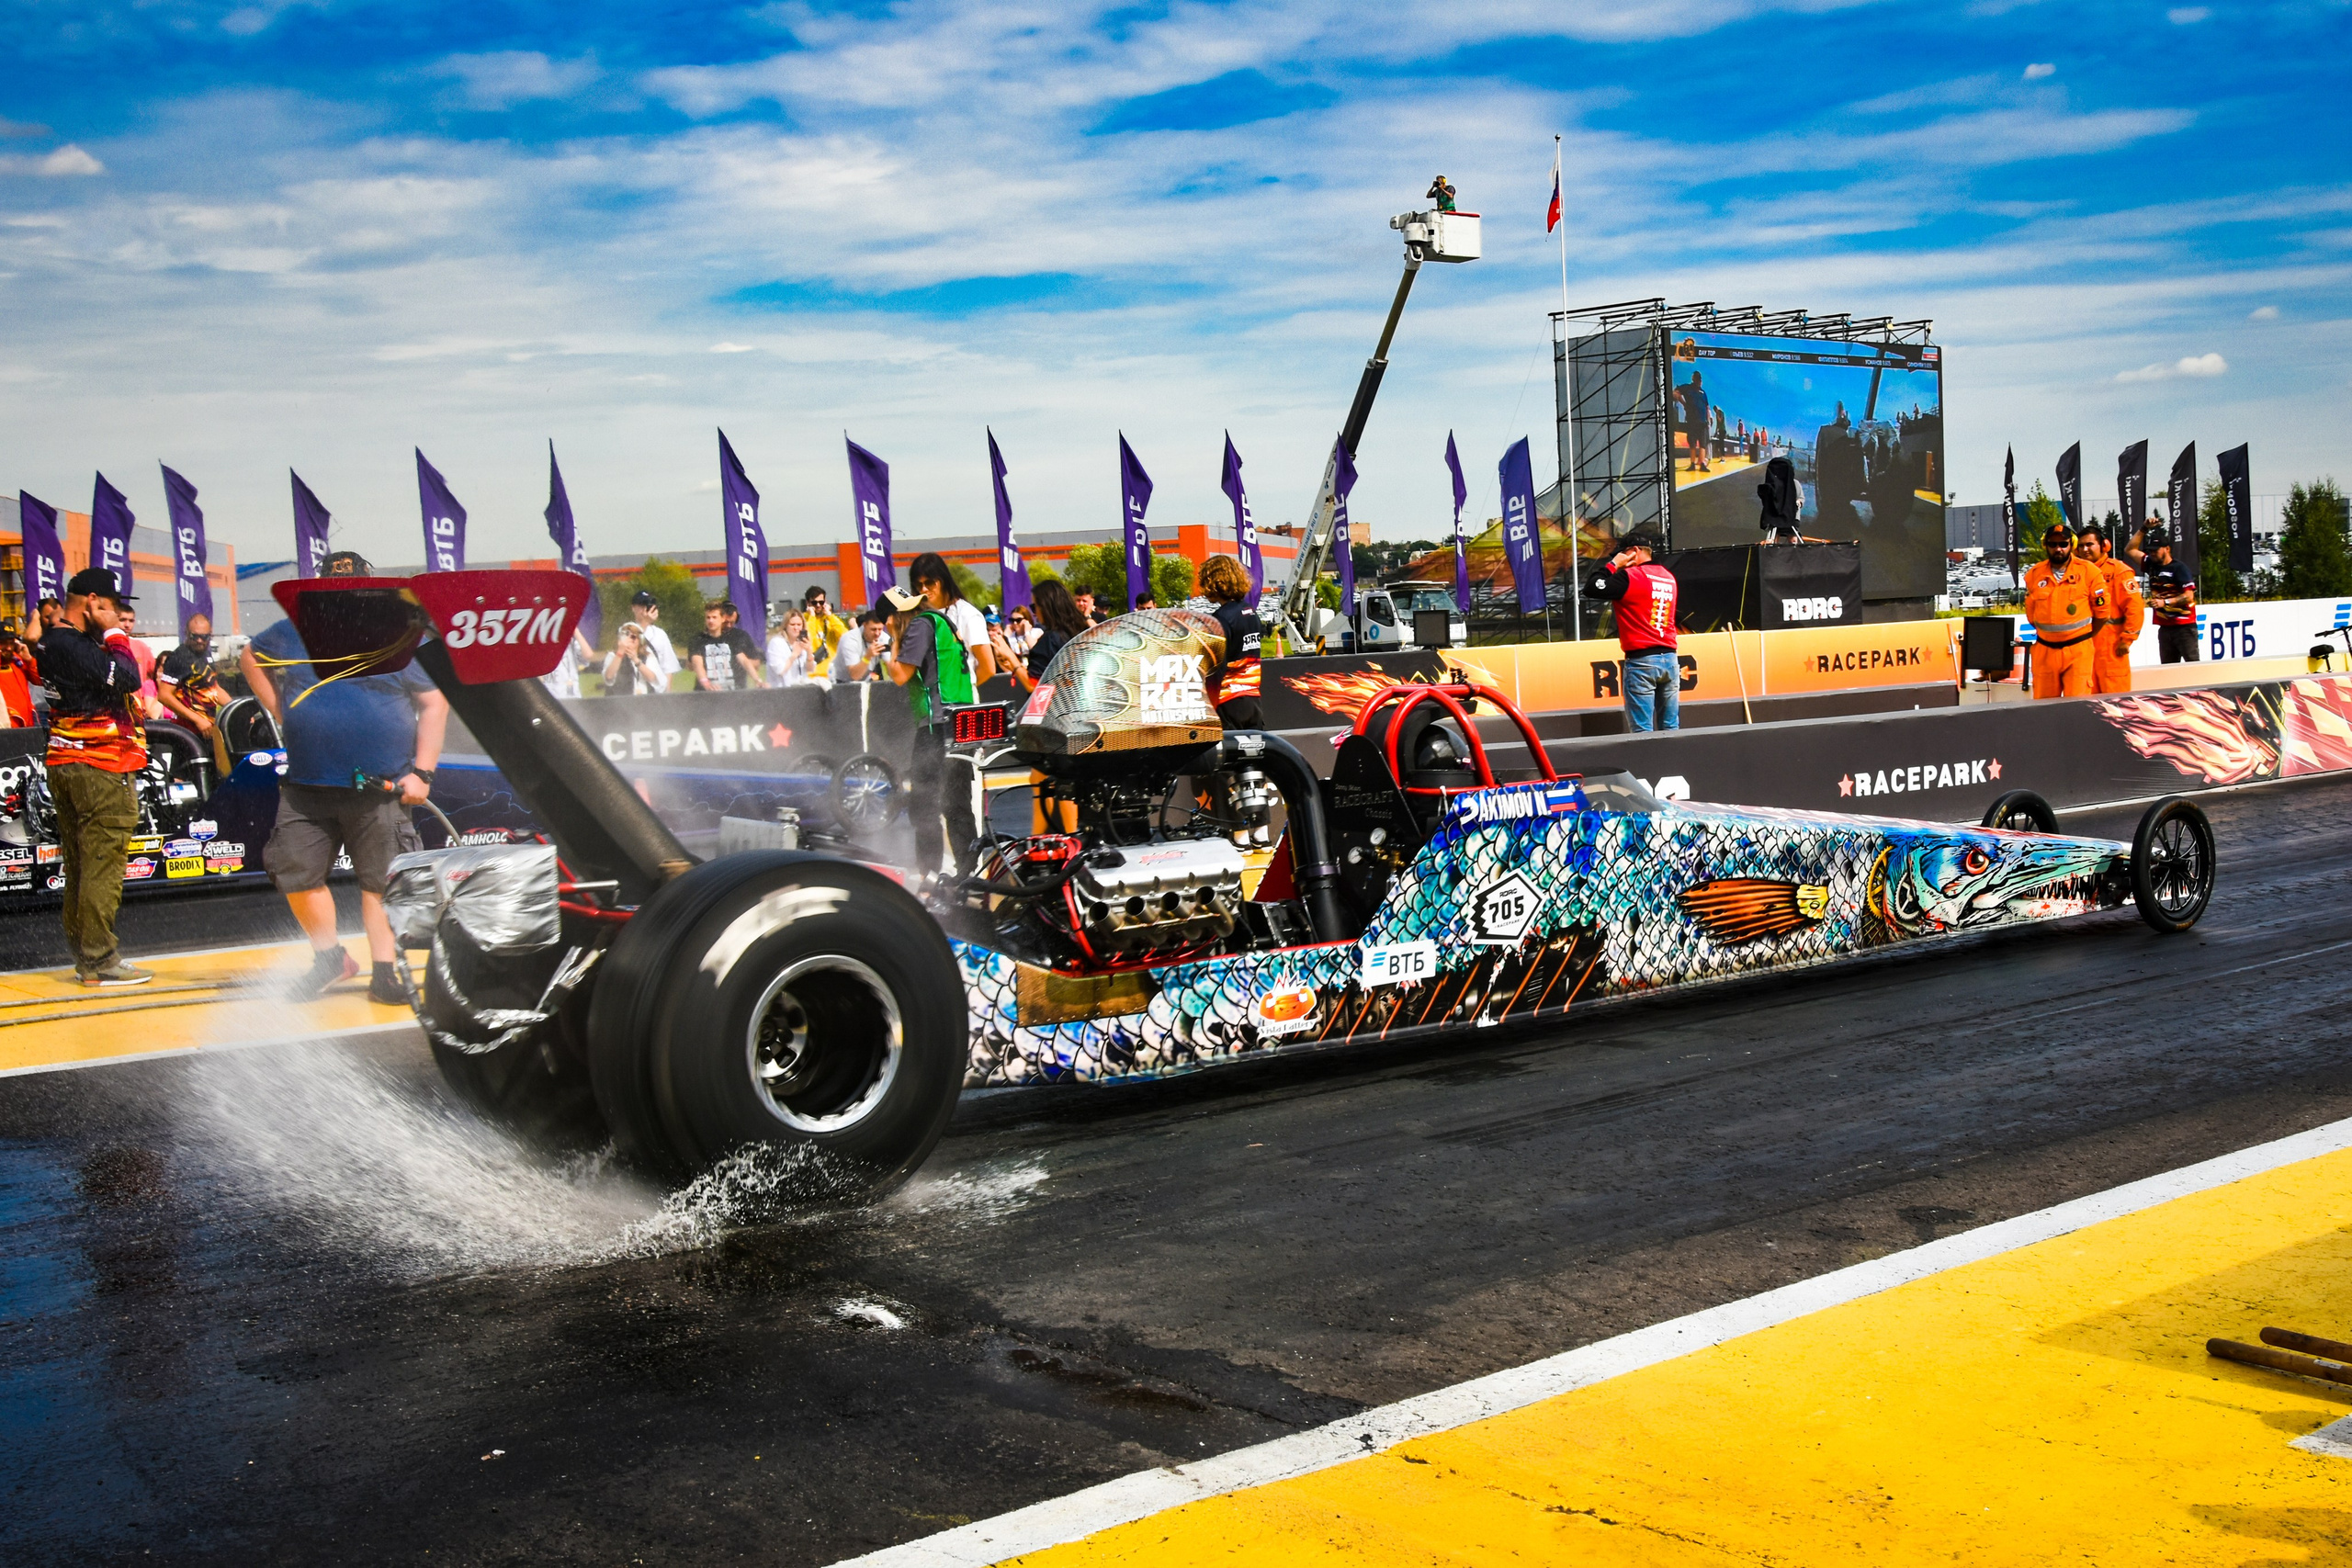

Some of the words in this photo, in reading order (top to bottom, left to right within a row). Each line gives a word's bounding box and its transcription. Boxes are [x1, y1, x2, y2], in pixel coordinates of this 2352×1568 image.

[863, 501, 885, 558] ВТБ
[103, 536, 125, 581] ТБ
[178, 526, 204, 578] ВТБ
[445, 606, 568, 649] 357M
[1781, 597, 1843, 622] RDRC
[2211, 619, 2256, 660] ВТБ
[1139, 654, 1204, 683] MAX
[1590, 654, 1698, 699] RC
[1816, 647, 1921, 673] RACEPARK
[603, 724, 766, 761] CEPARK
[1854, 759, 1987, 797] RACEPARK
[169, 861, 201, 872] BRODIX
[211, 845, 243, 854] WELD
[1488, 895, 1524, 923] 705
[1389, 951, 1425, 976] ВТБ
